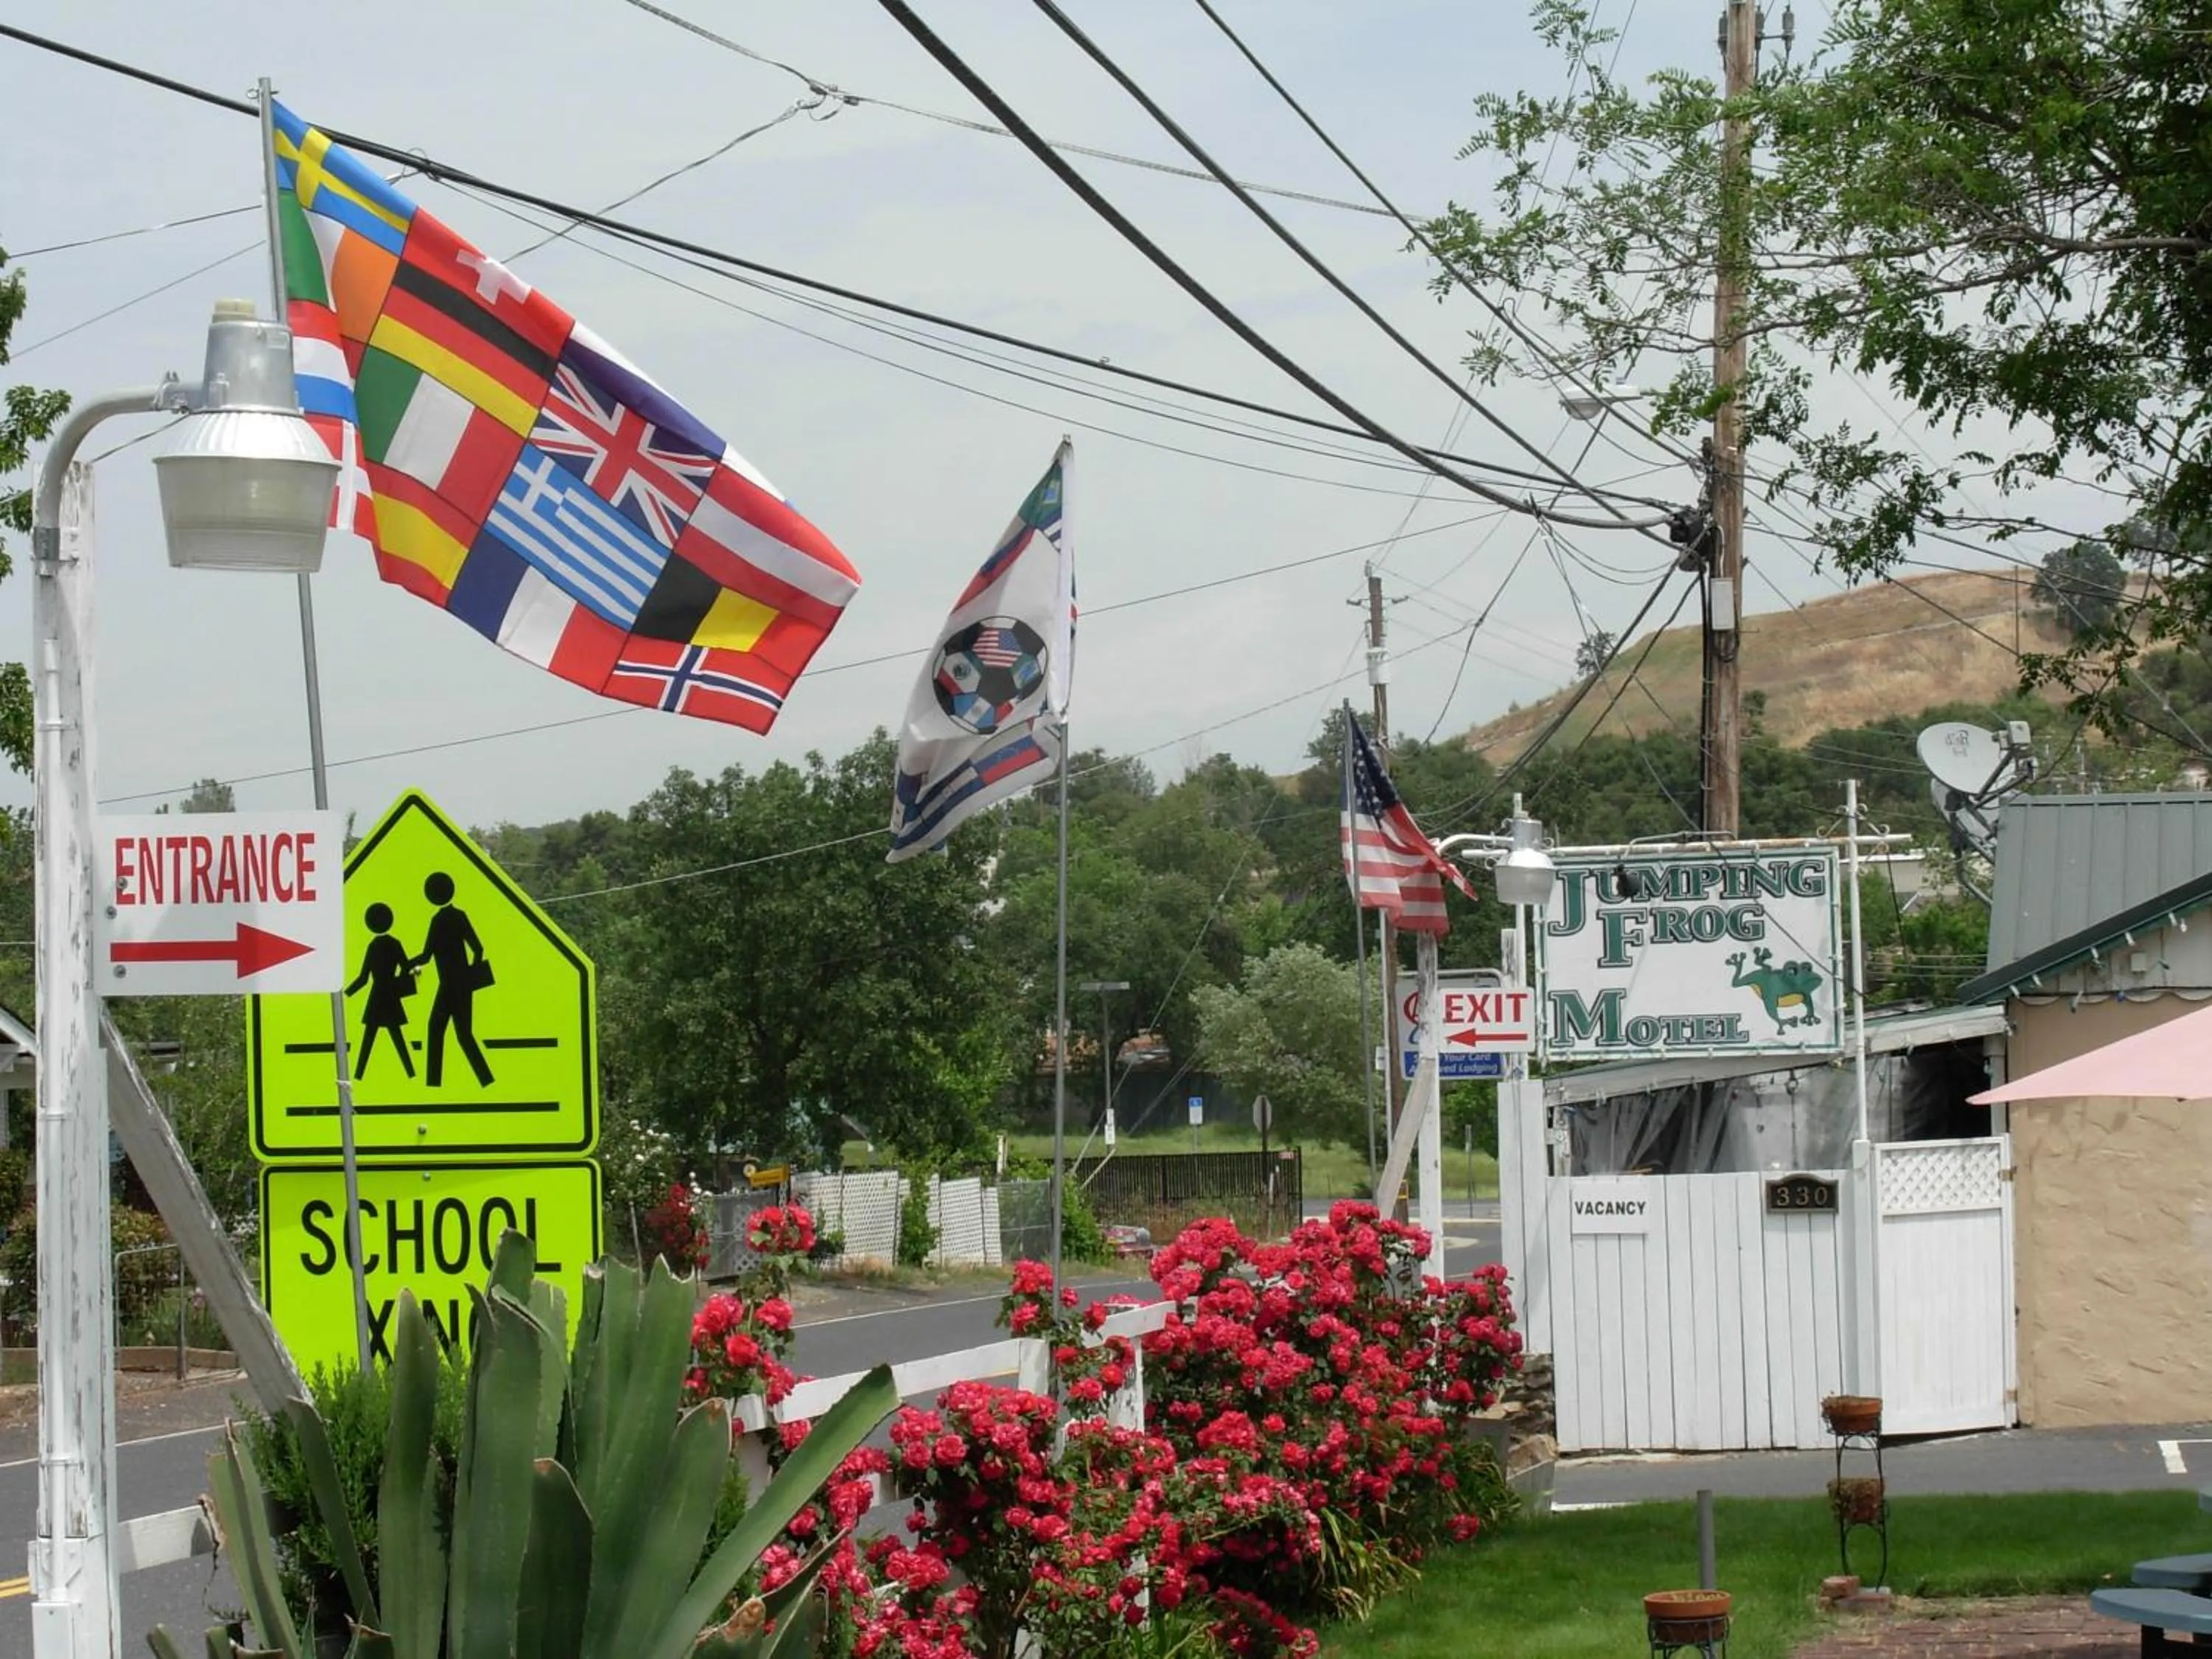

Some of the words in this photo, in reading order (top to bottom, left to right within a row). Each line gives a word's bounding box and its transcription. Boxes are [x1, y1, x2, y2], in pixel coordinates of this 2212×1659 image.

[115, 832, 316, 905] ENTRANCE
[1548, 860, 1826, 937] JUMPING
[1597, 903, 1765, 968] FROG
[1443, 993, 1528, 1023] EXIT
[1548, 988, 1750, 1047] MOTEL
[1573, 1200, 1647, 1216] VACANCY
[1776, 1186, 1829, 1206] 330
[300, 1197, 562, 1276] SCHOOL
